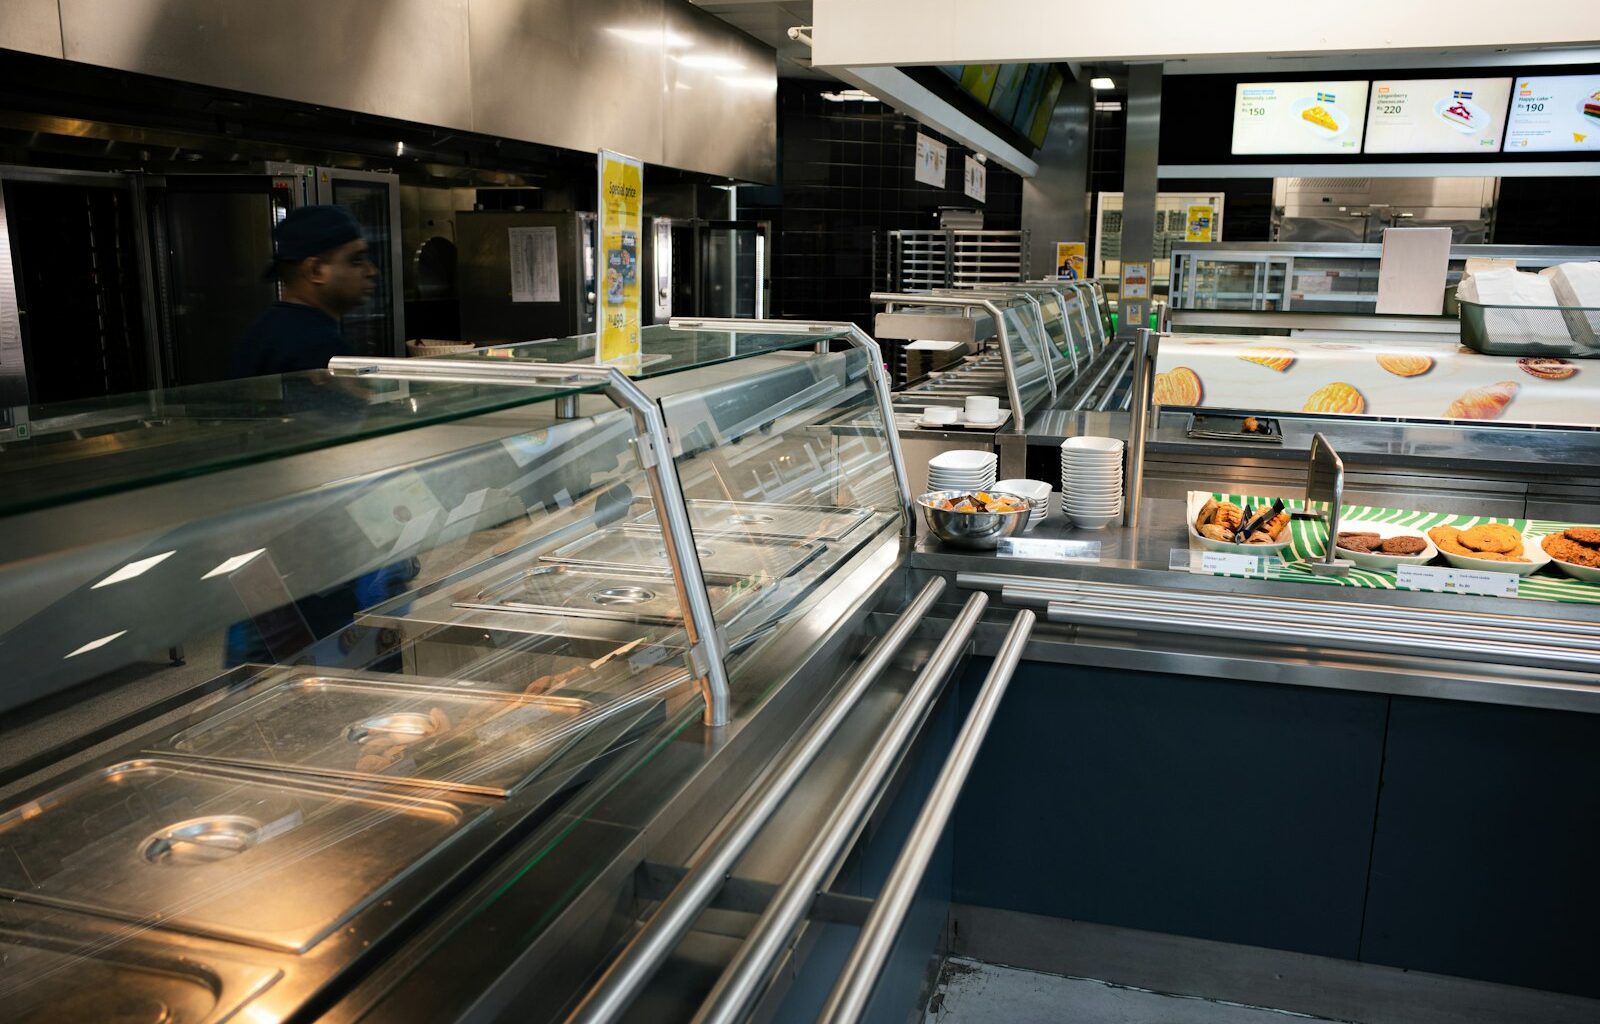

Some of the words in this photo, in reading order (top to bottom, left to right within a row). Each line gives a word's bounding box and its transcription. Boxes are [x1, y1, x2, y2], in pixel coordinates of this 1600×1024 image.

[1249, 107, 1265, 116] 150
[1384, 105, 1402, 114] 220
[1526, 103, 1544, 112] 190
[609, 181, 625, 198] Special
[625, 184, 637, 200] price
[613, 312, 624, 329] 499
